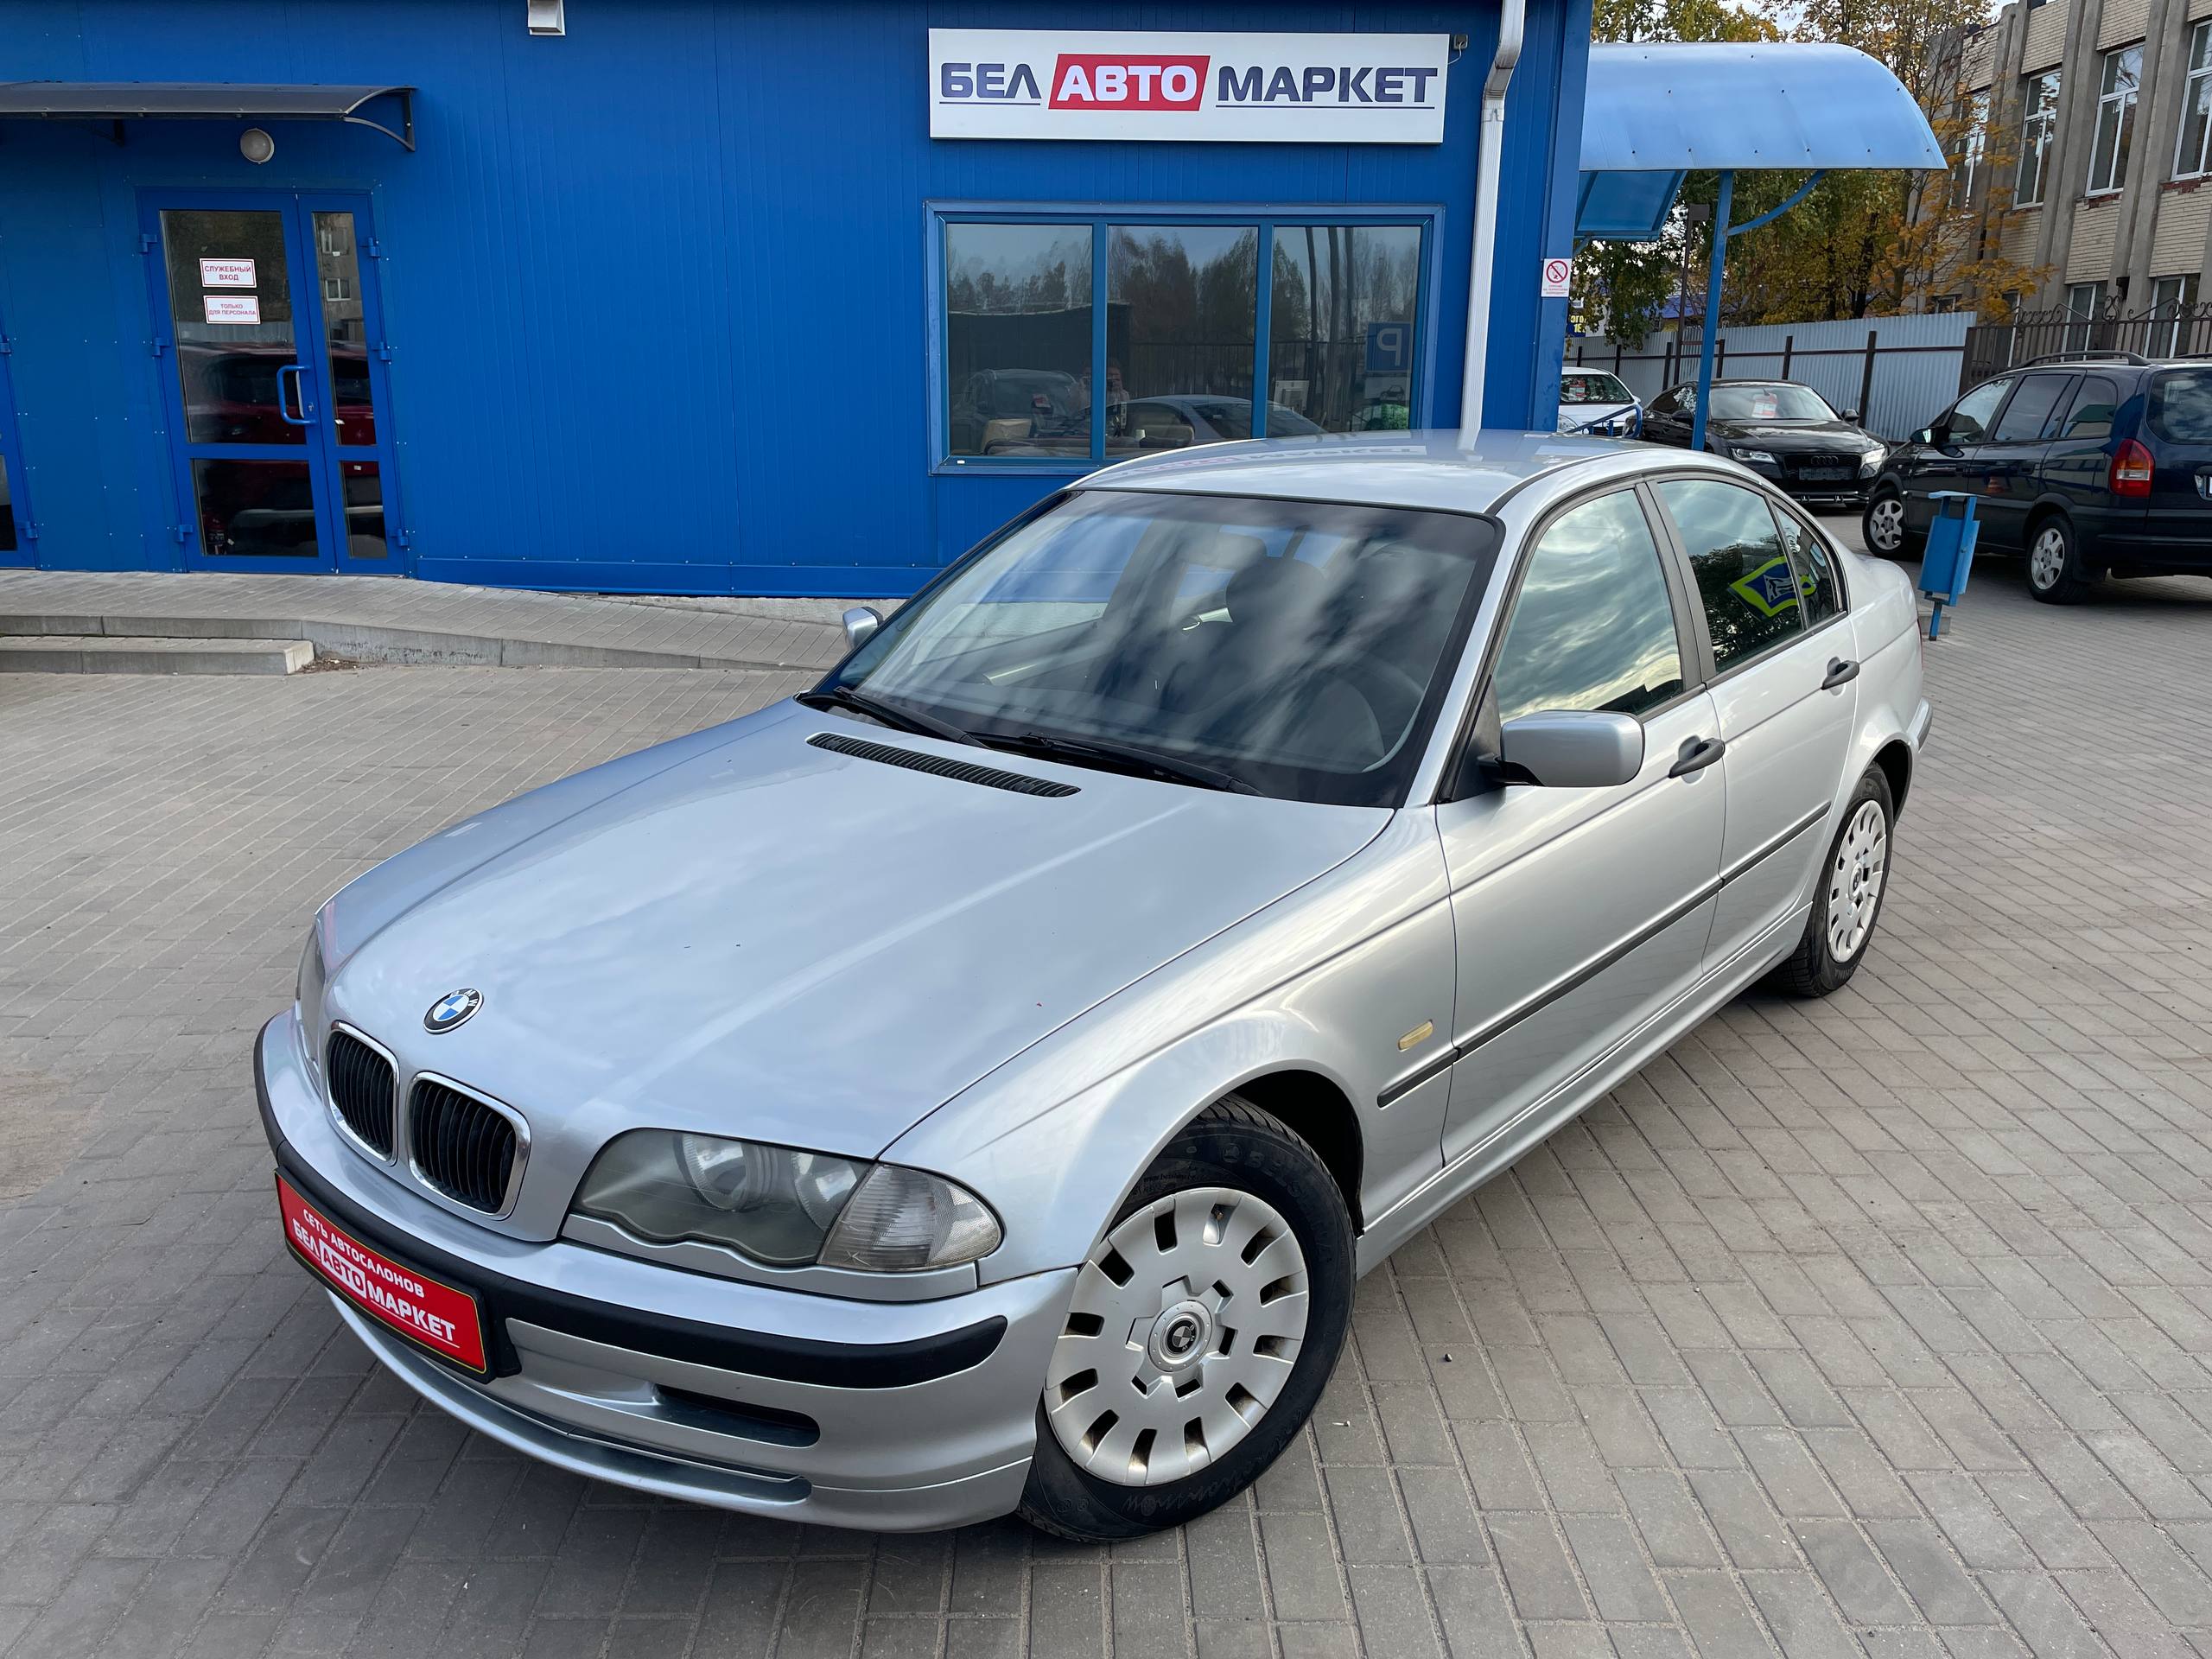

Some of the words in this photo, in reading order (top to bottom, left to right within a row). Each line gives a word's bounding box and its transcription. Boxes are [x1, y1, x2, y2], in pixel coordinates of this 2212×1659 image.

[941, 62, 1042, 99] БЕЛ
[1057, 65, 1198, 102] АВТО
[1217, 66, 1438, 103] МАРКЕТ
[204, 264, 251, 273] СЛУЖЕБНЫЙ
[292, 1217, 321, 1258] БЕЛ
[321, 1243, 365, 1296] АВТО
[367, 1280, 456, 1342] МАРКЕТ
[303, 1209, 328, 1238] СЕТЬ
[330, 1232, 425, 1299] АВТОСАЛОНОВ
